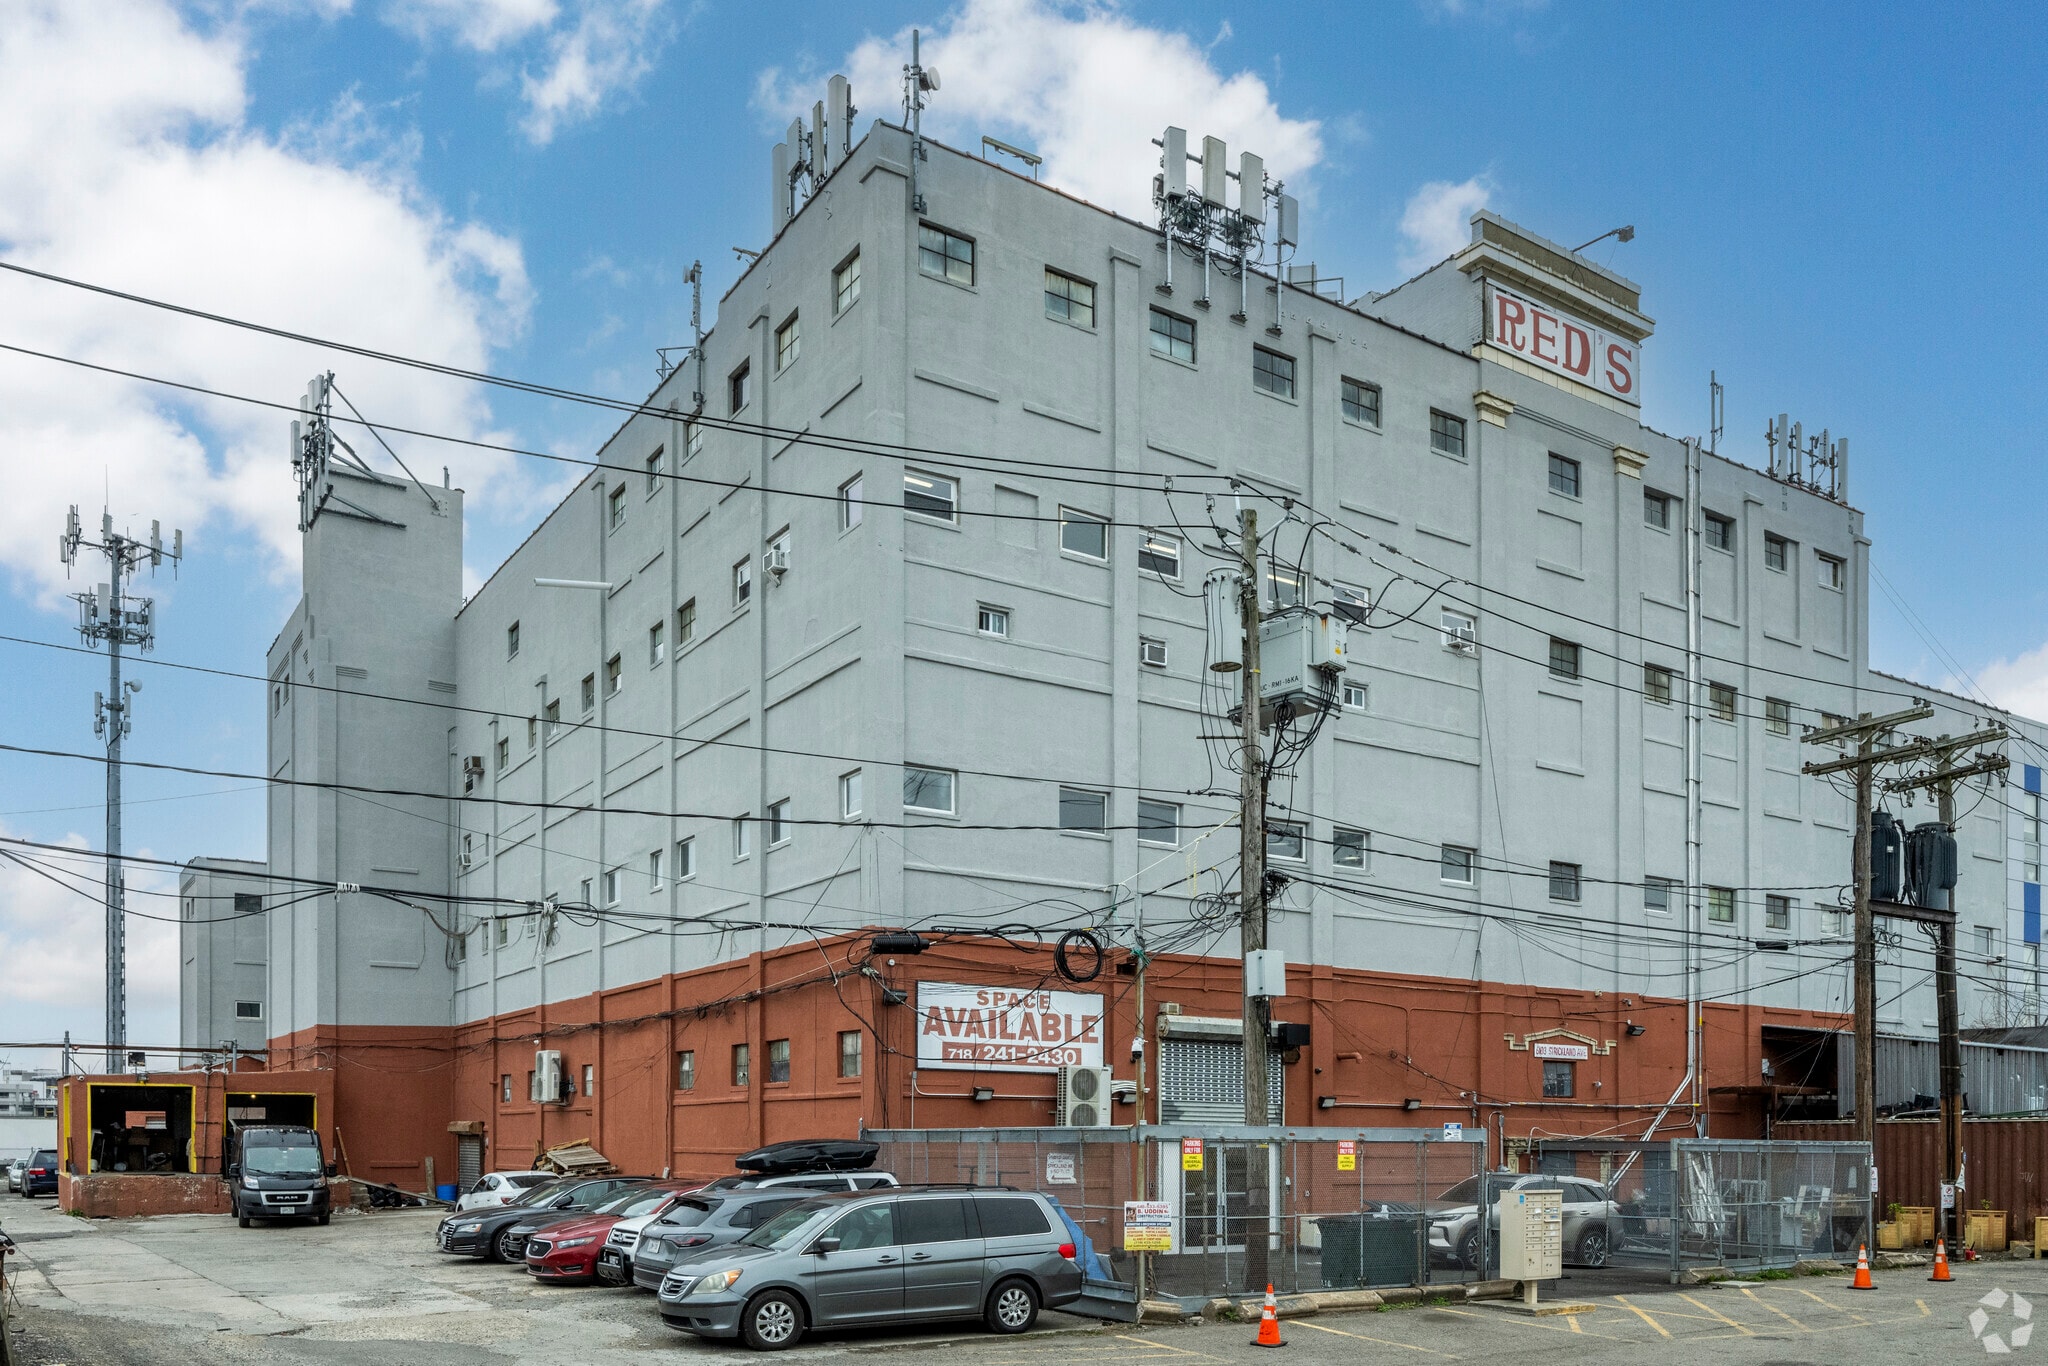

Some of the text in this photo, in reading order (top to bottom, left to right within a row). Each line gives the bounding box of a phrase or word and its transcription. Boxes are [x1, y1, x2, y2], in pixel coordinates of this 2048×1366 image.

[1496, 294, 1633, 394] RED'S
[976, 989, 1050, 1010] SPACE
[922, 1005, 1099, 1044] AVAILABLE
